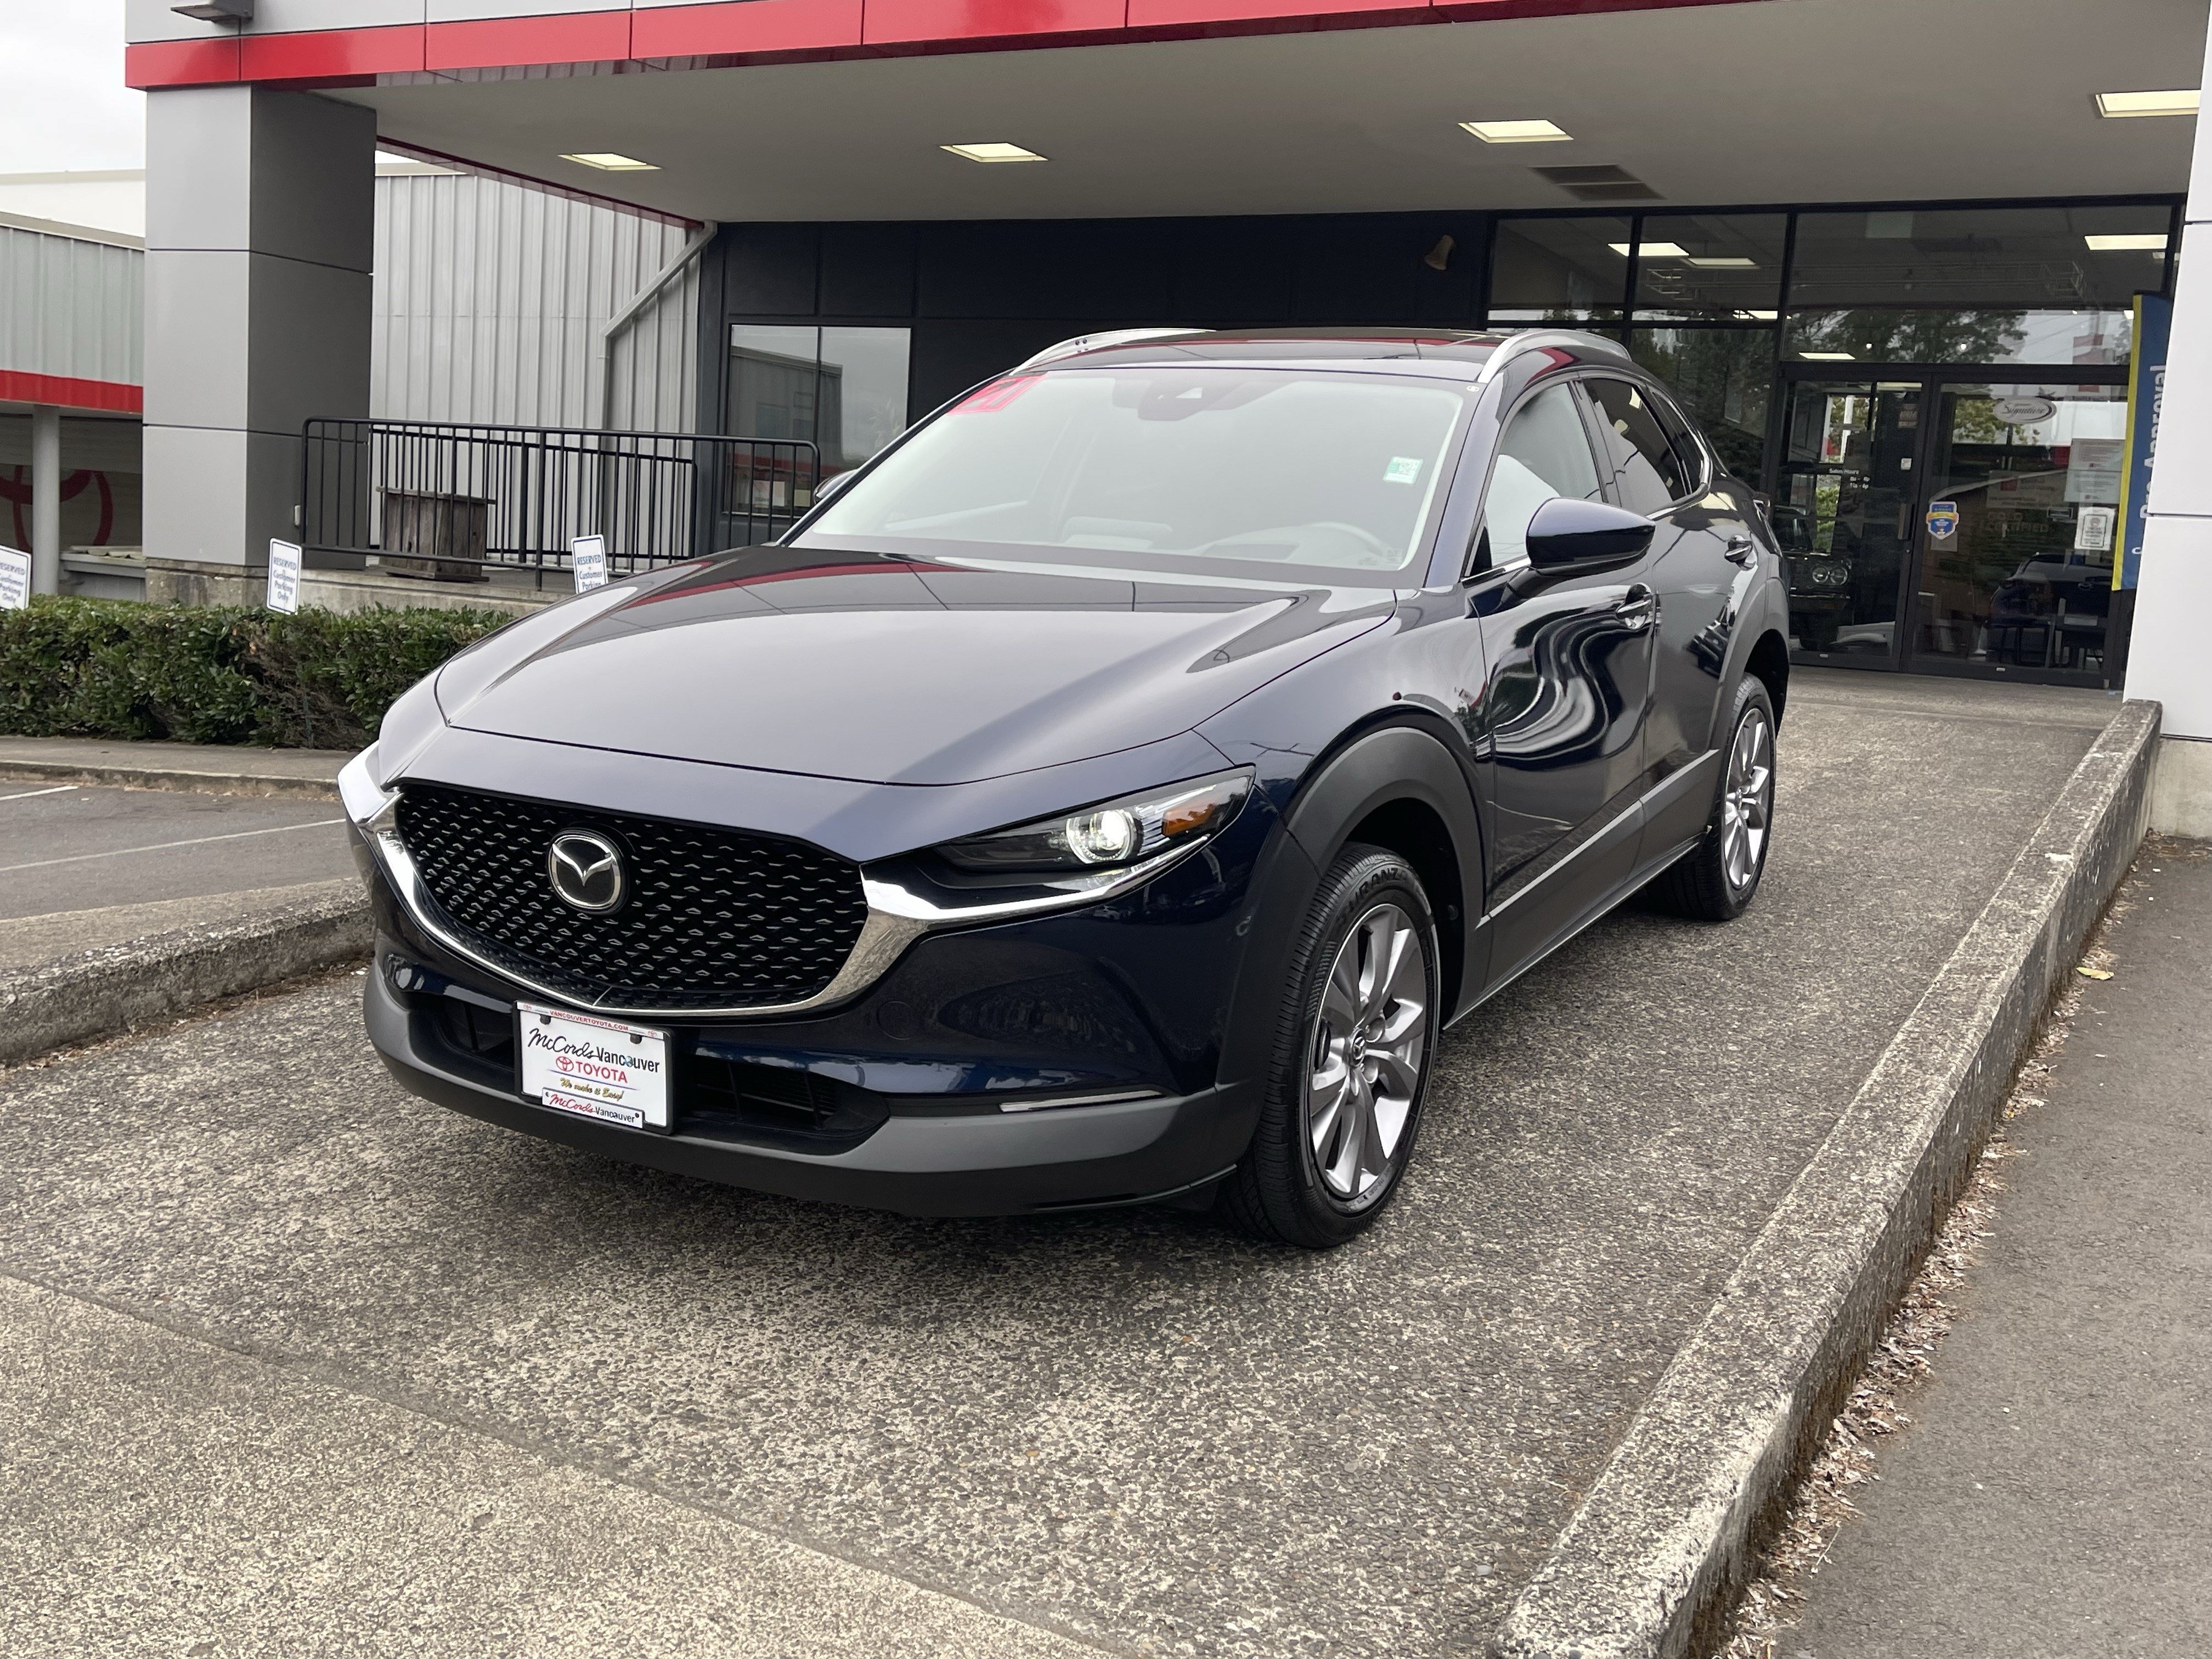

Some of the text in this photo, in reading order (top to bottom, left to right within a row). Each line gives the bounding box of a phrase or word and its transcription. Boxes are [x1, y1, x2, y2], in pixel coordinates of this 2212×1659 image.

[274, 557, 296, 569] RESERVED
[577, 555, 601, 565] RESERVED
[0, 562, 25, 575] ESERVED
[0, 574, 24, 587] ustomer
[273, 569, 296, 583] Customer
[579, 571, 602, 580] Customer
[274, 580, 293, 595] Parking
[277, 591, 289, 603] Only
[549, 1010, 629, 1031] VANCOUVERTOYOTA.COM
[575, 1060, 628, 1084] TOYOTA
